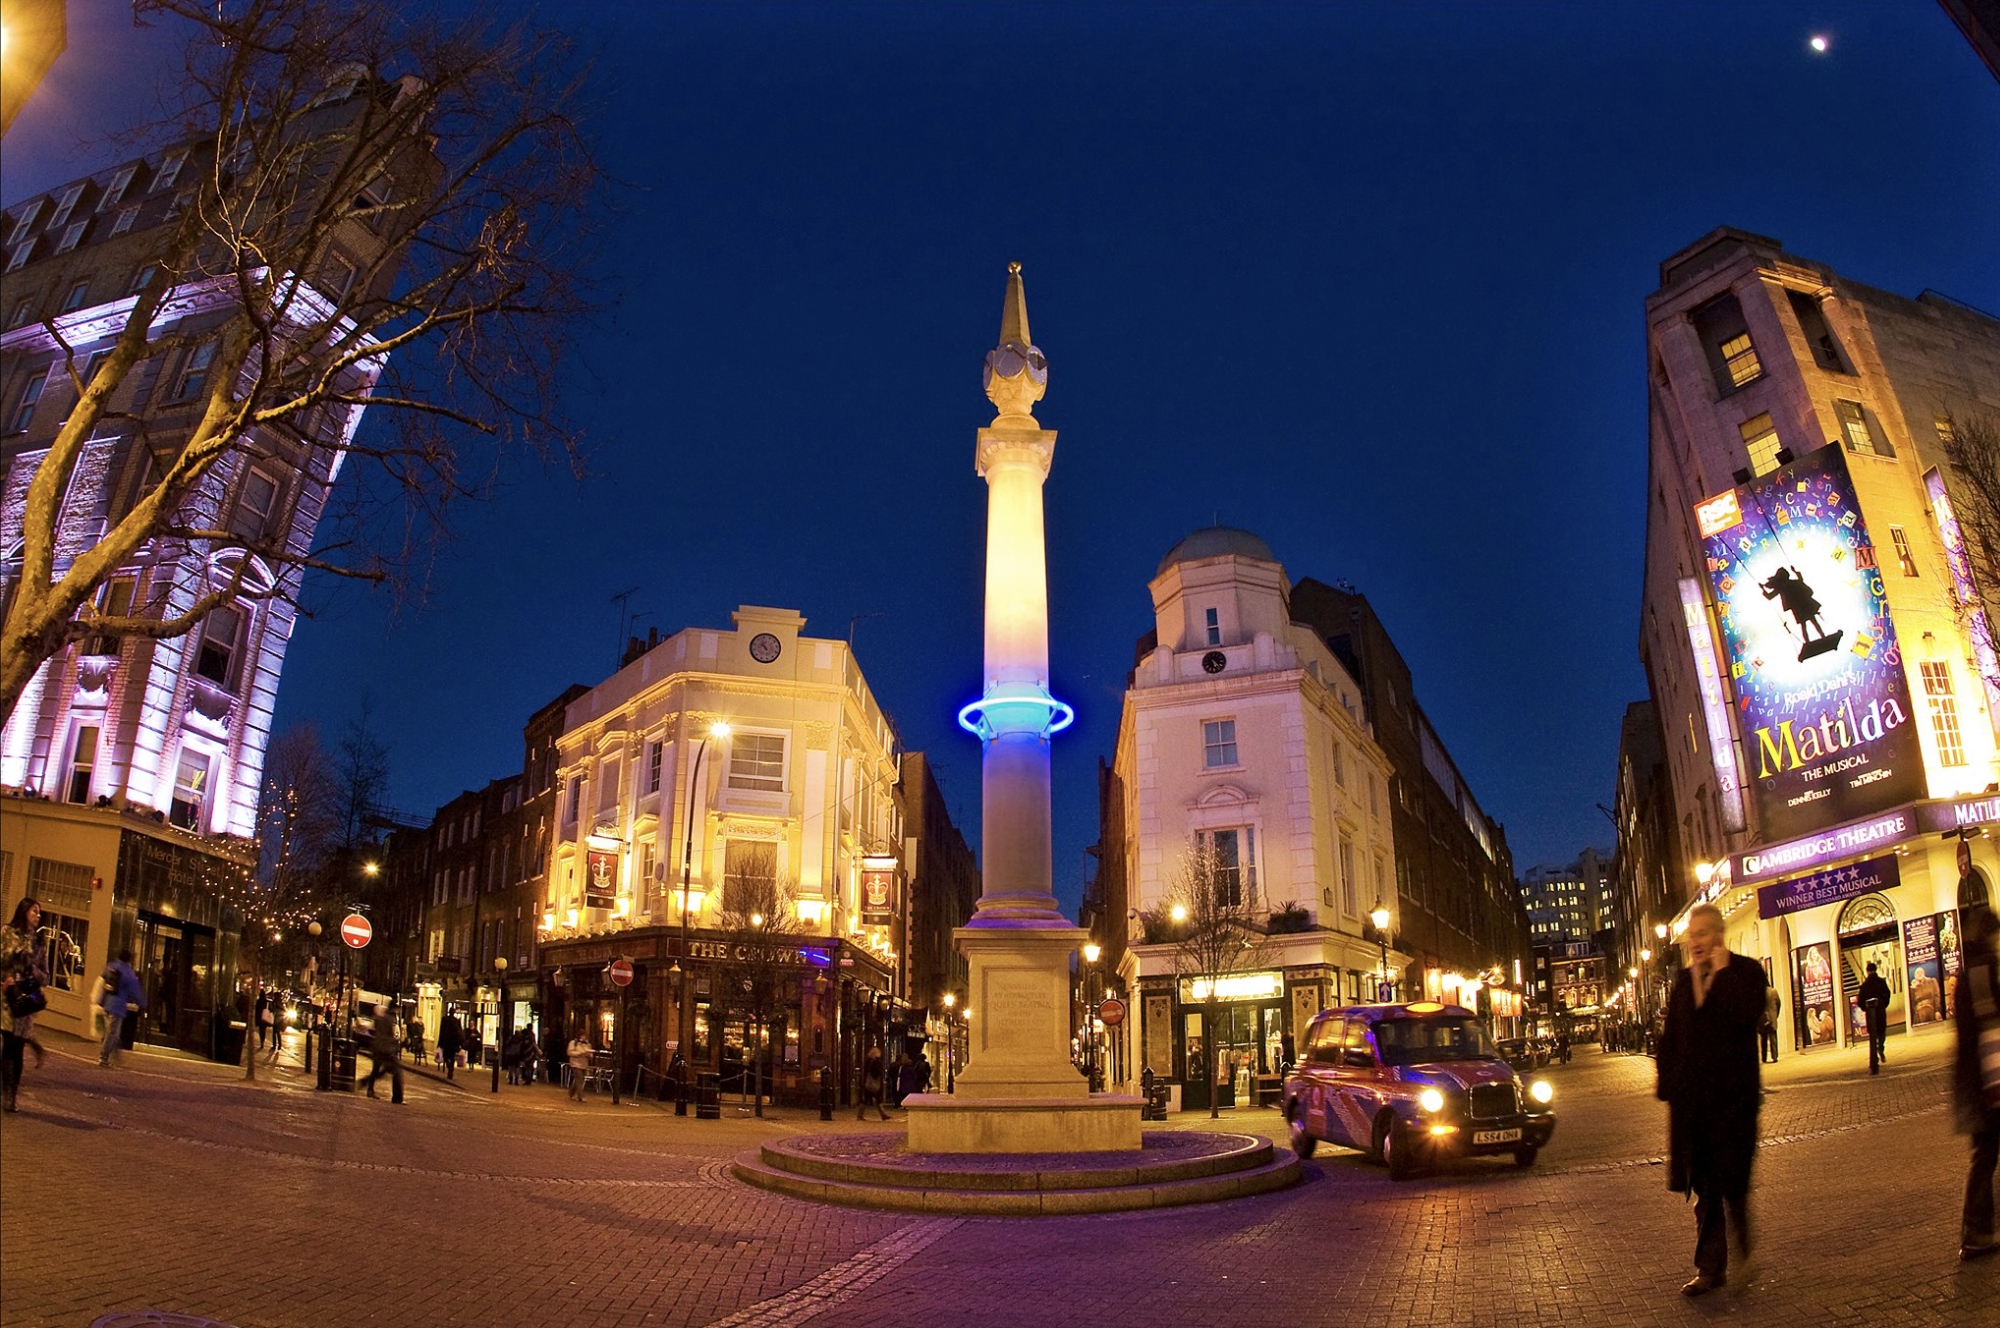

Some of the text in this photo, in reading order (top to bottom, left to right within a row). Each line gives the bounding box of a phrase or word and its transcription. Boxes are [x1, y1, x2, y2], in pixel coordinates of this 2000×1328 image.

[1698, 494, 1736, 523] RSC
[1683, 602, 1737, 793] Matilda
[1784, 682, 1818, 704] Roald
[1754, 696, 1907, 779] Matilda
[1801, 766, 1824, 782] THE
[1824, 753, 1870, 776] MUSICAL
[1787, 793, 1812, 807] DENNIS
[1811, 788, 1832, 801] KELLY
[147, 845, 182, 866] Mercer
[1743, 816, 1906, 875] CAMBRIDGE THEATRE
[1775, 874, 1882, 909] WINNER BEST MUSICAL
[688, 941, 728, 959] THE
